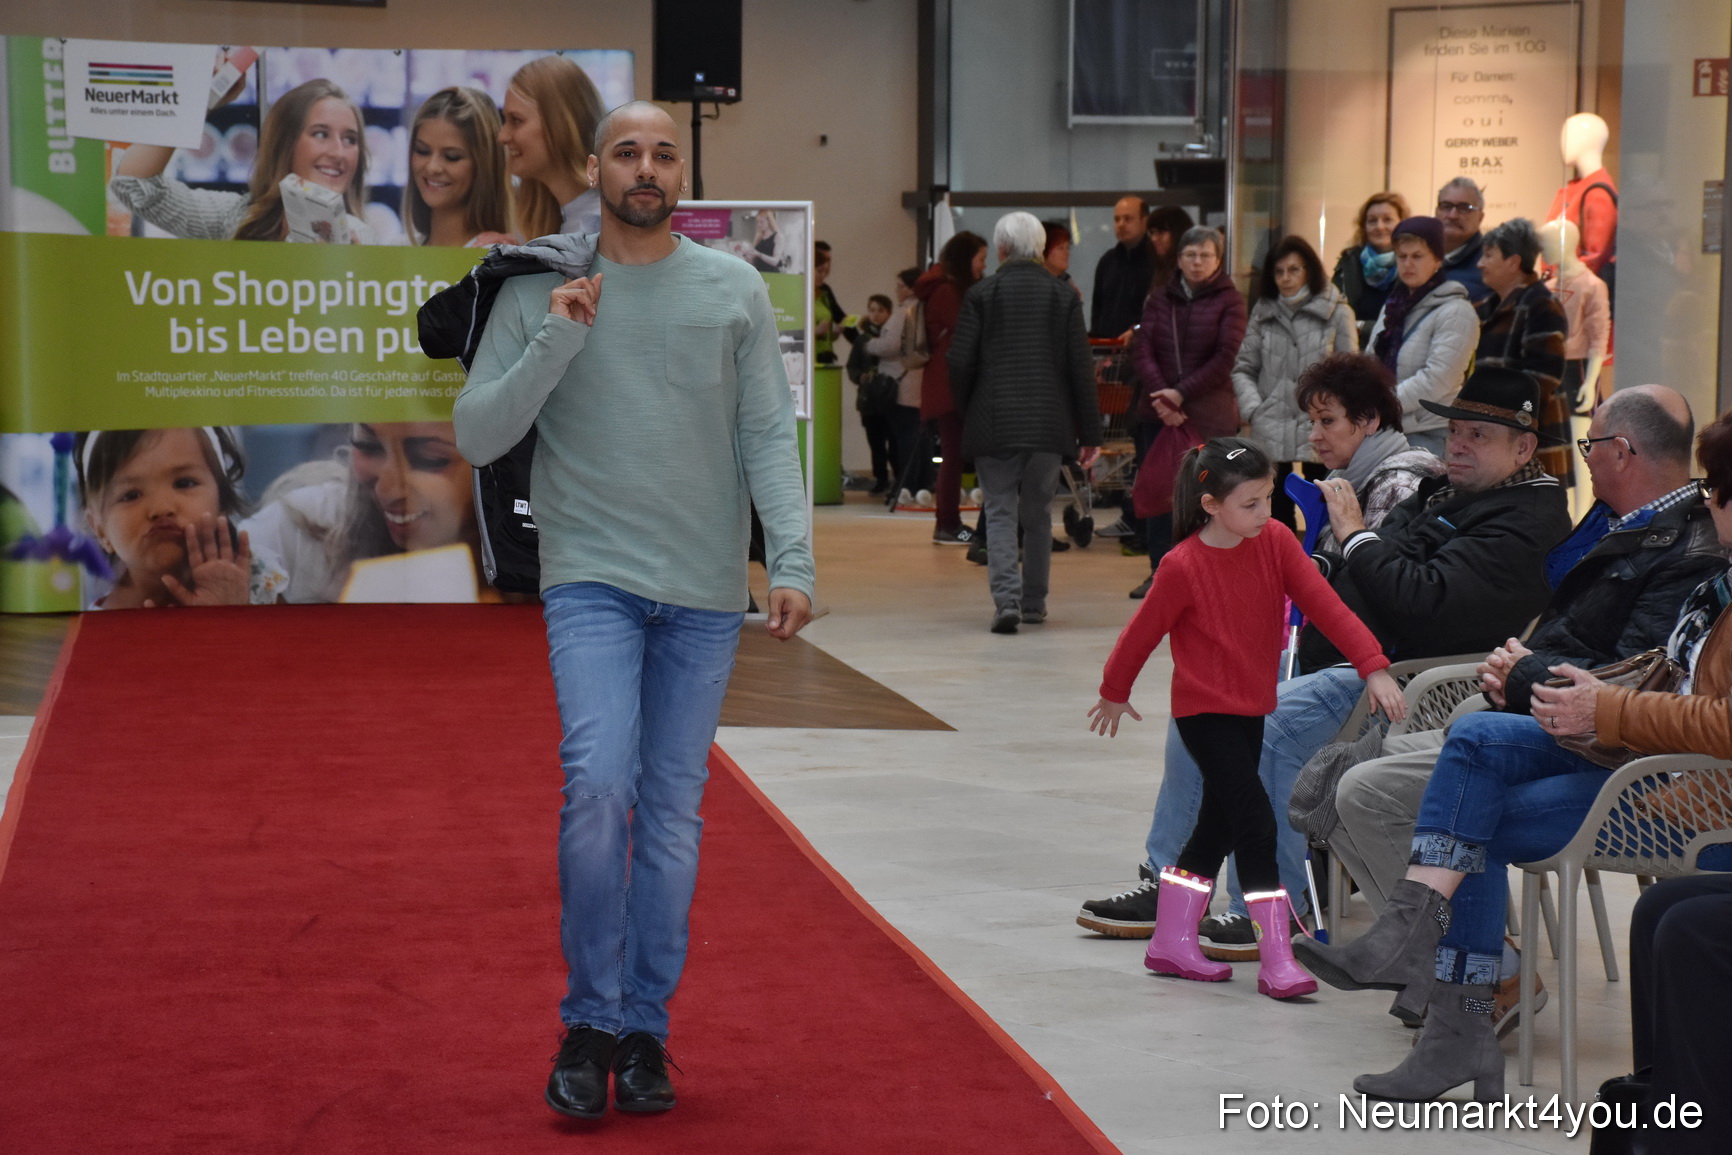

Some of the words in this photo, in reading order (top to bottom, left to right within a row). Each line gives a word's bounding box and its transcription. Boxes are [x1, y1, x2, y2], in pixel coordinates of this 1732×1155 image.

[1439, 26, 1477, 39] Diese
[1482, 25, 1530, 36] Marken
[1424, 42, 1464, 56] finden
[1469, 42, 1489, 55] Sie
[1494, 41, 1510, 54] im
[1451, 72, 1469, 83] Für
[85, 87, 179, 105] NeuerMarkt
[89, 106, 107, 115] Alles
[108, 107, 129, 116] unter
[130, 108, 154, 117] einem
[155, 108, 177, 117] Dach.
[1445, 138, 1479, 148] GERRY
[1482, 137, 1518, 147] WEBER
[1460, 157, 1503, 168] BRAX
[125, 270, 201, 306] Von
[212, 270, 461, 316] Shoppingto
[170, 318, 228, 354] bis
[239, 318, 364, 354] Leben
[117, 371, 130, 382] Im
[132, 370, 208, 384] Stadtquartier
[289, 370, 328, 382] treffen
[331, 370, 348, 382] 40
[350, 369, 409, 382] Geschäfte
[411, 370, 429, 382] auf
[145, 385, 221, 399] Multiplexkino
[223, 385, 245, 397] und
[247, 384, 327, 397] Fitnessstudio.
[330, 385, 346, 397] Da
[349, 386, 364, 397] ist
[366, 385, 383, 397] für
[384, 385, 417, 399] jeden
[419, 387, 443, 398] was
